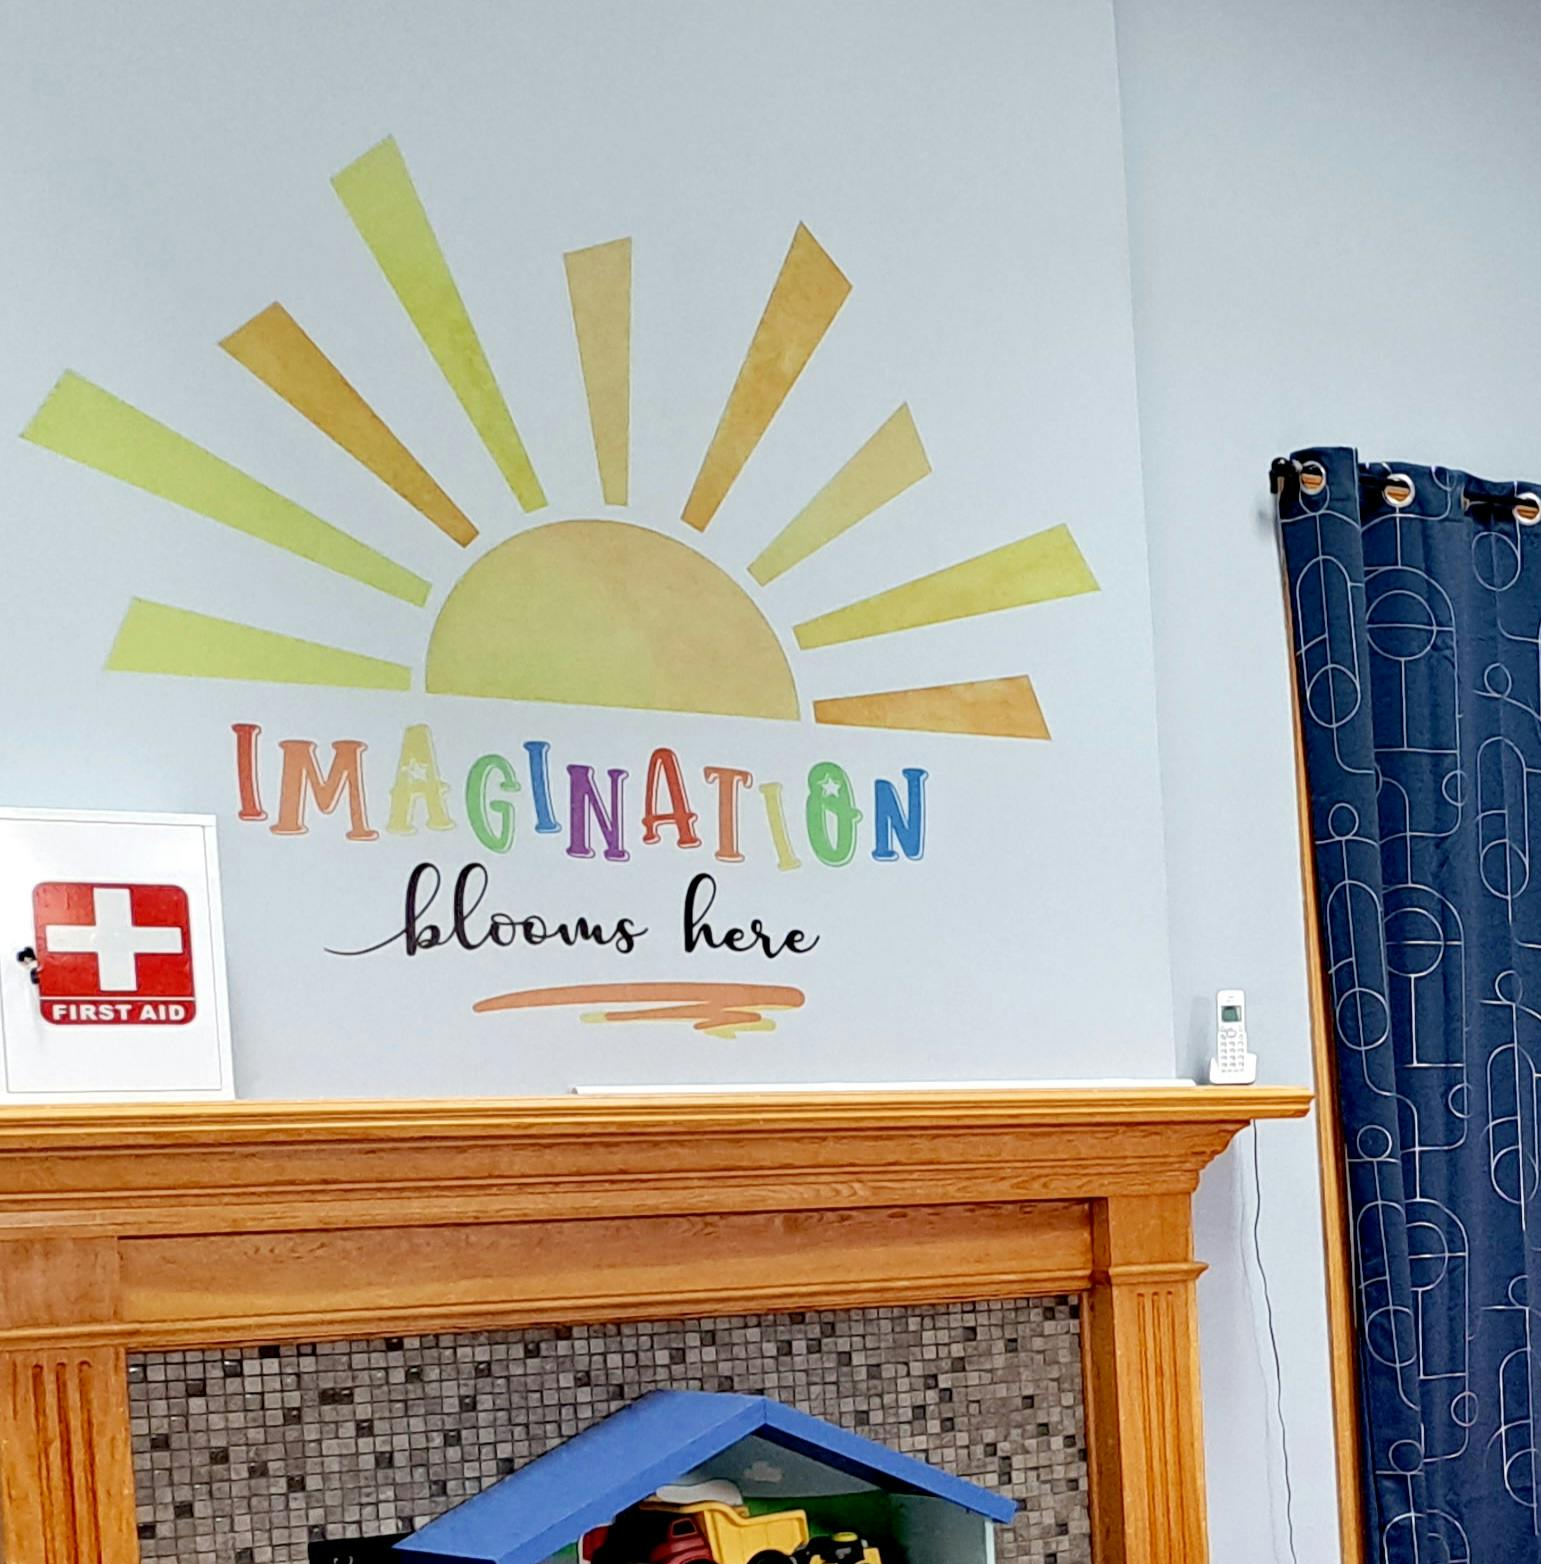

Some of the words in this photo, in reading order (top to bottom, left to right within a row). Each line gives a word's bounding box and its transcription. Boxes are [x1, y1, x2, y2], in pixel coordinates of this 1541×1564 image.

[230, 722, 928, 871] IMAGINATION
[325, 862, 648, 957] blooms
[683, 873, 820, 958] here
[52, 1002, 131, 1024] FIRST
[139, 1002, 186, 1024] AID
